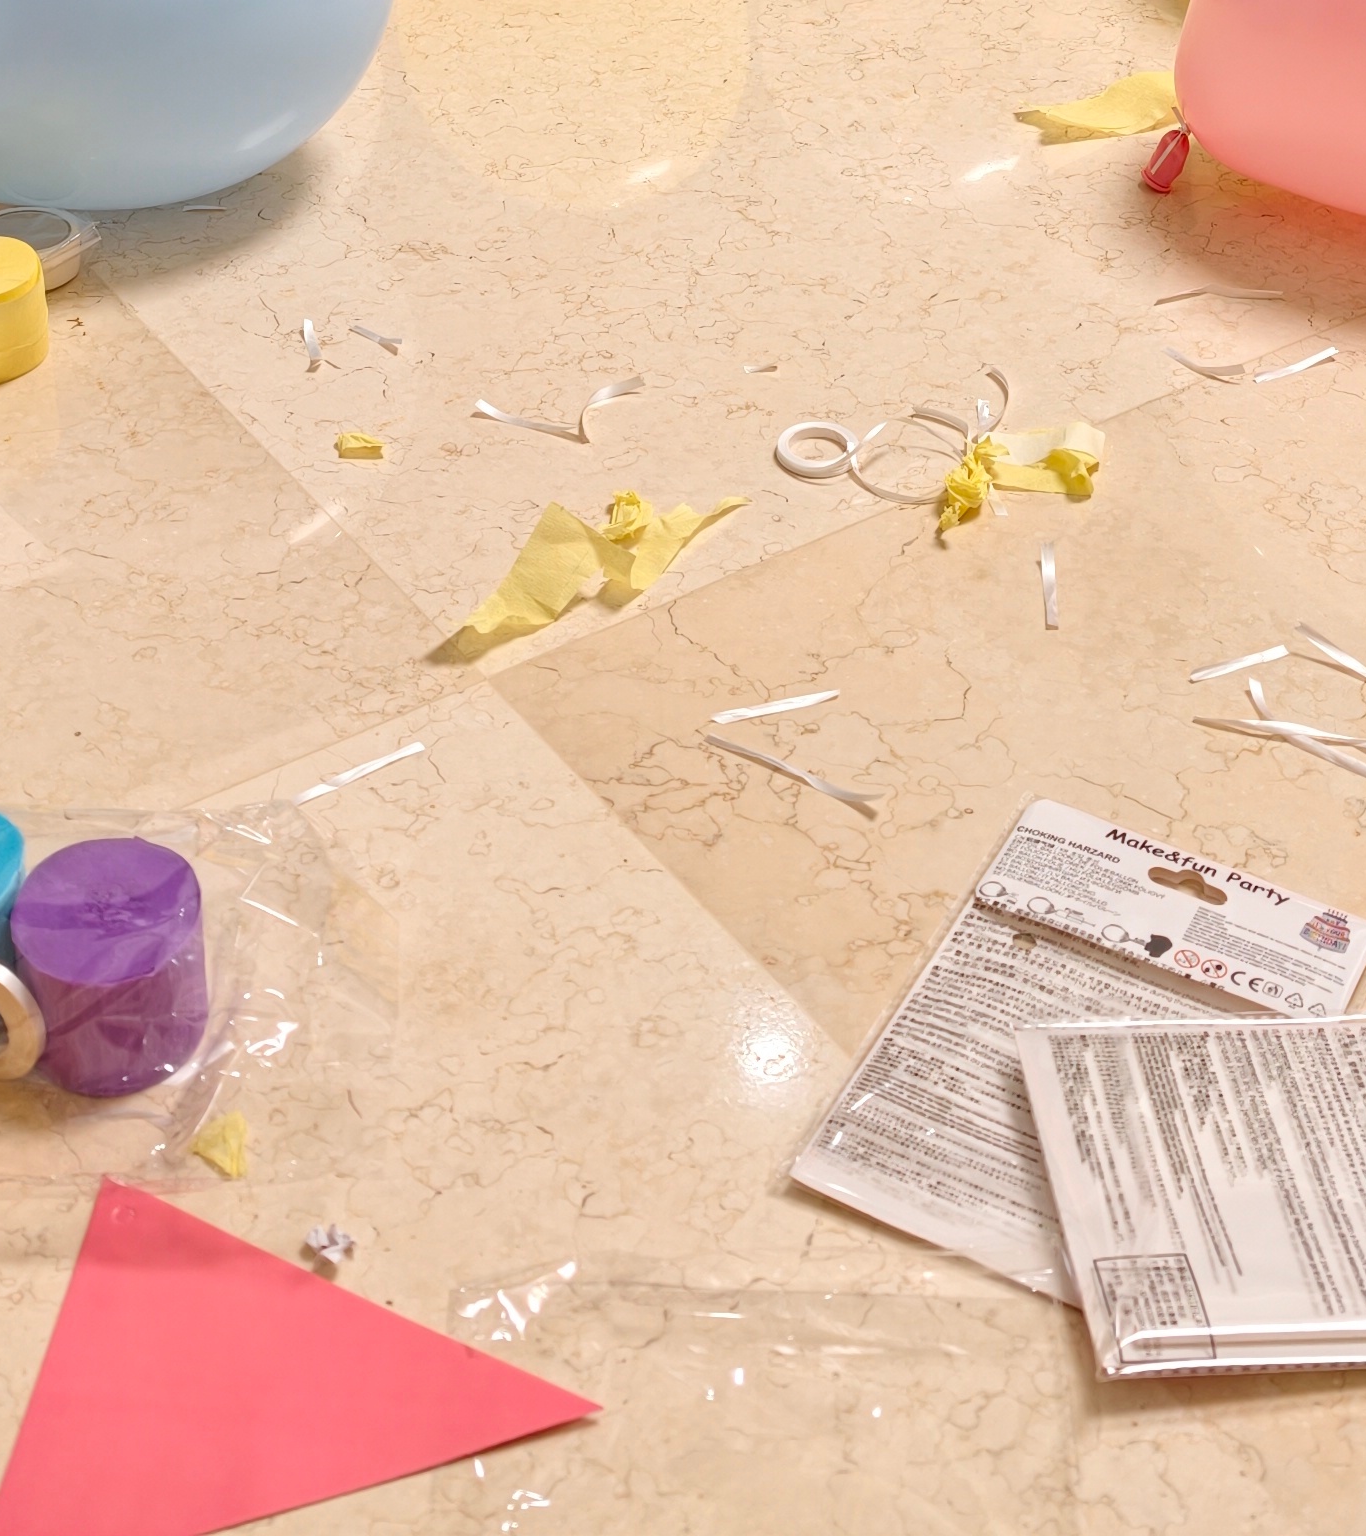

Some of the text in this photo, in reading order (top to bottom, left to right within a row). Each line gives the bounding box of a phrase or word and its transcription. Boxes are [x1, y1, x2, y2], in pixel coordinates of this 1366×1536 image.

[1016, 825, 1121, 865] CHOKING HARZARD
[1105, 828, 1291, 906] Make&fun Party
